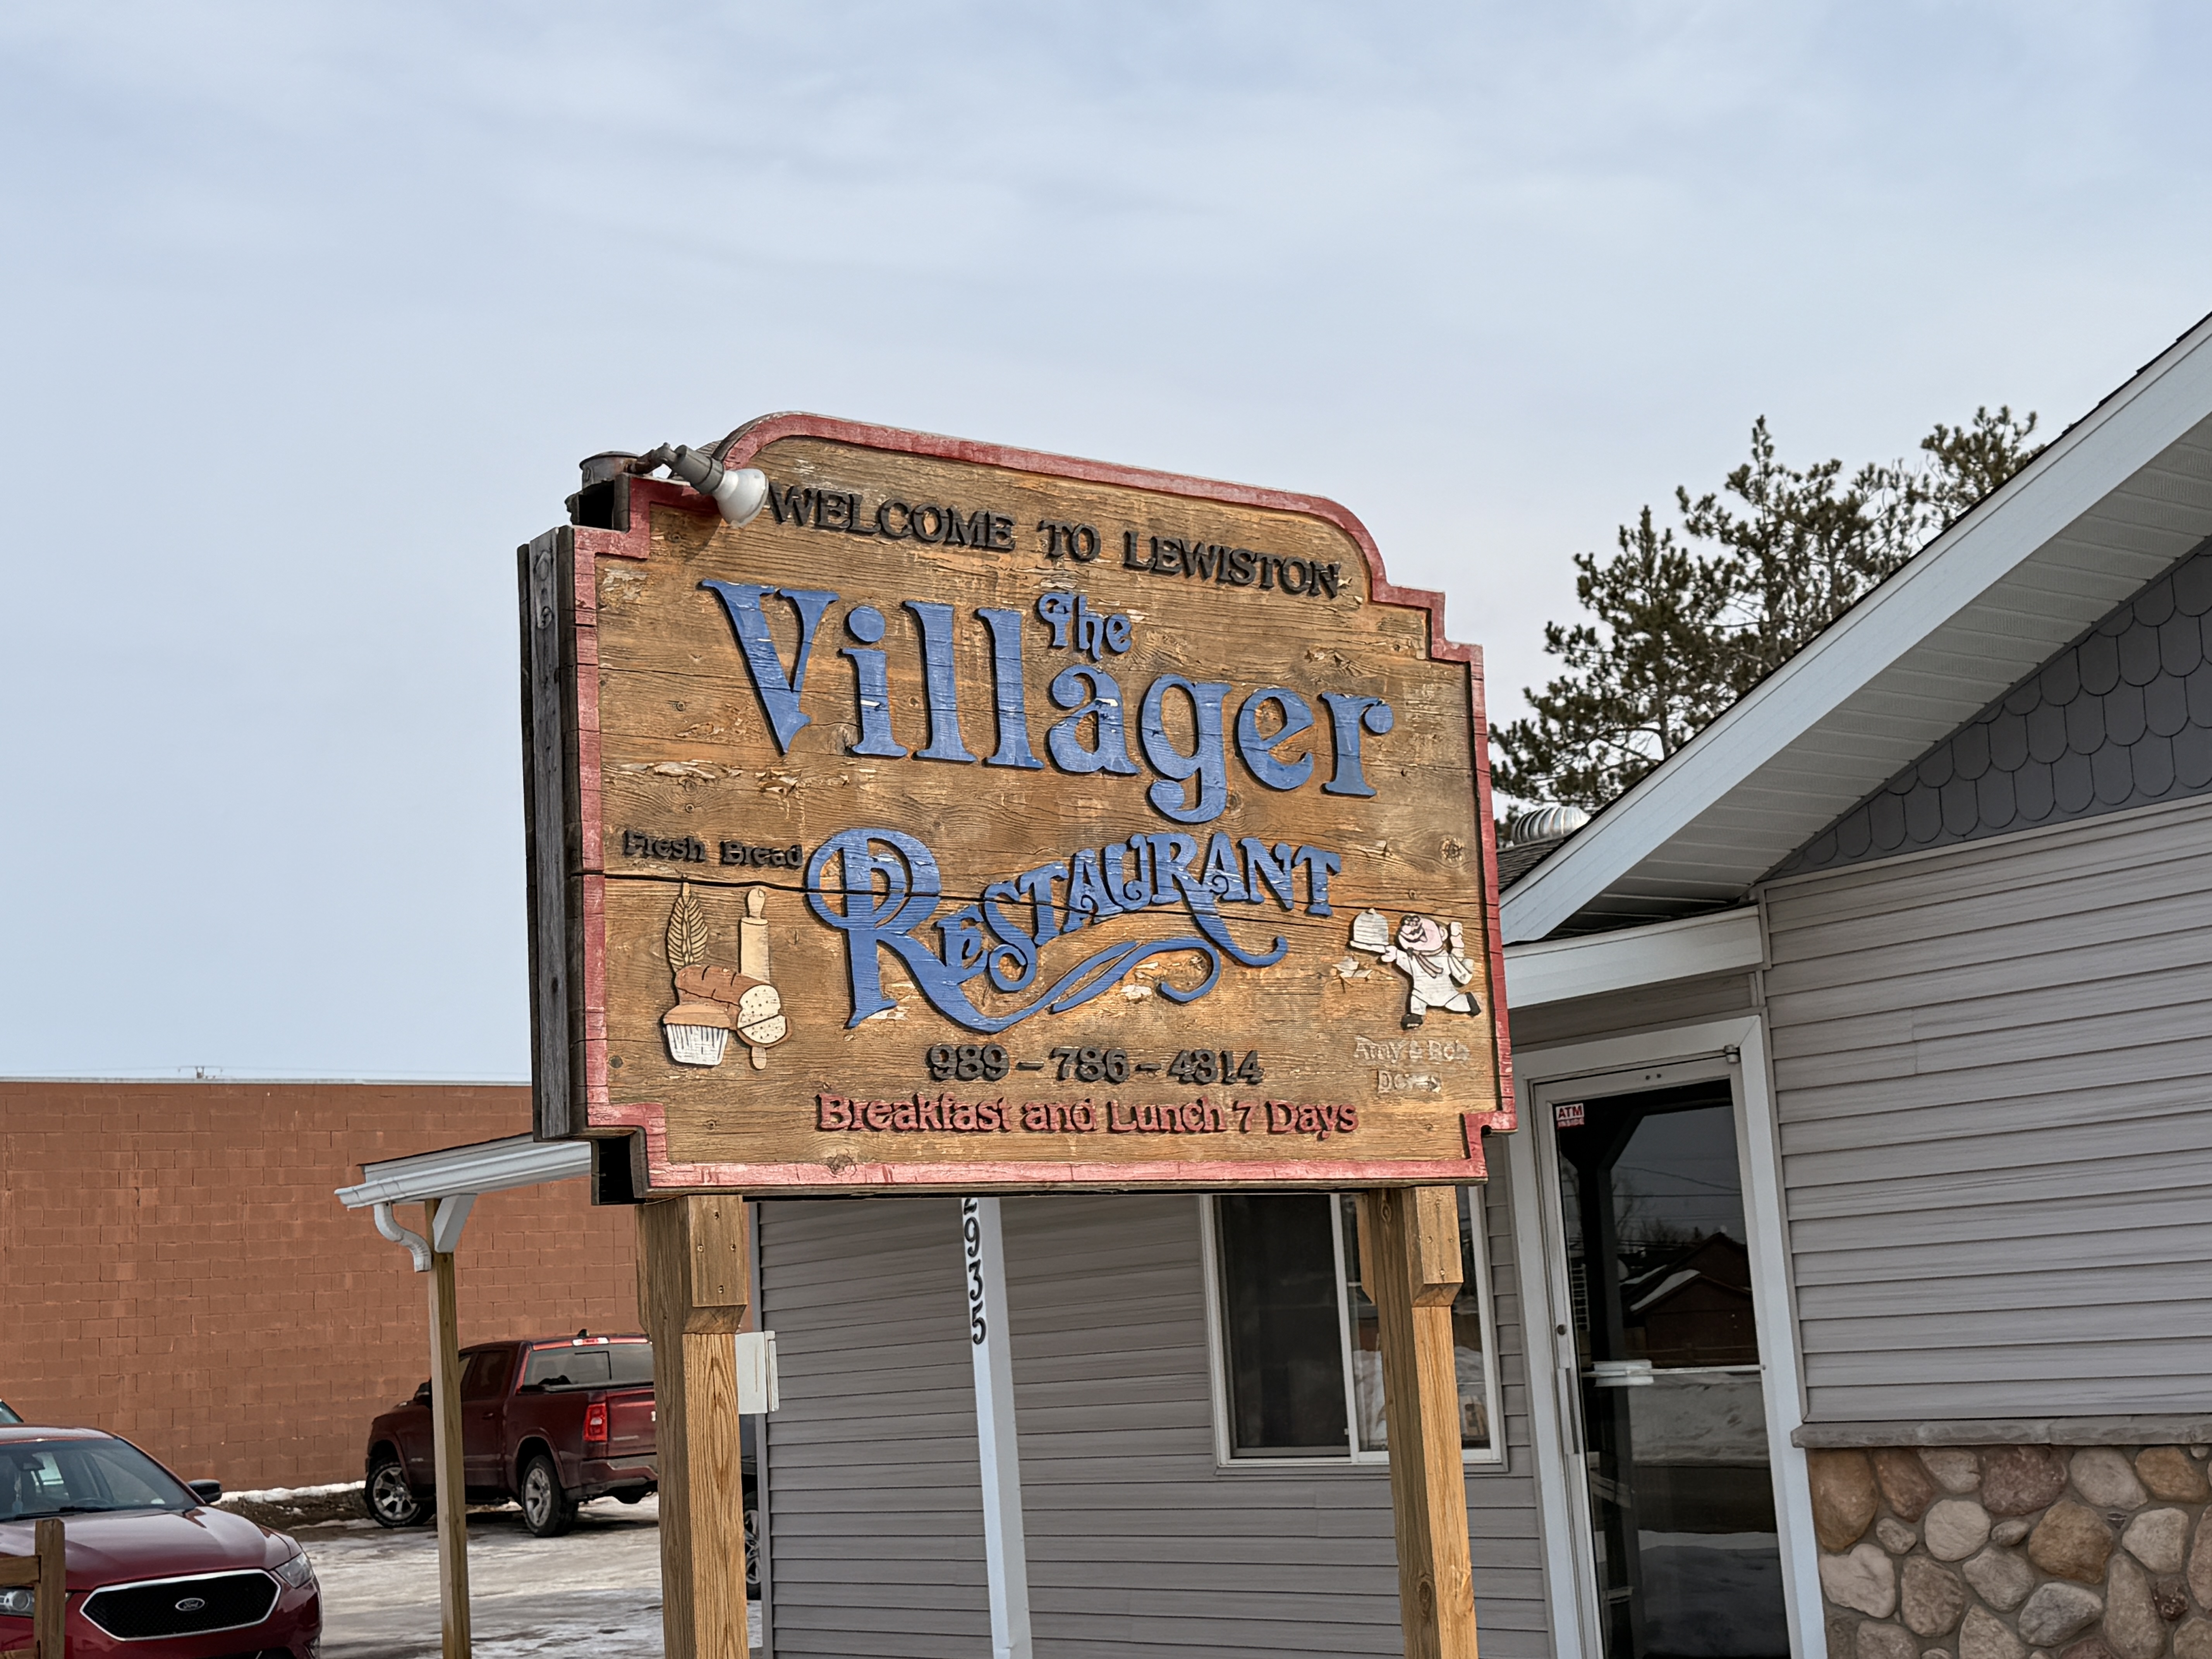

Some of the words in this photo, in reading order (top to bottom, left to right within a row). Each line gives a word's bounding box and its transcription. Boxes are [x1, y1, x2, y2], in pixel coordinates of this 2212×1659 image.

[767, 483, 1016, 551] WELCOME
[1036, 520, 1102, 562] TO
[1122, 531, 1341, 599] LEWISTON
[1036, 592, 1132, 661] The
[700, 580, 1394, 824] Villager
[622, 830, 706, 862] Fresh
[720, 840, 804, 869] Bread
[815, 1091, 1011, 1132] Breakfast
[1019, 1098, 1097, 1132] and
[1107, 1096, 1226, 1133] Lunch
[1232, 1099, 1258, 1133] 7
[1266, 1100, 1359, 1140] Days
[1558, 1105, 1583, 1118] ATM
